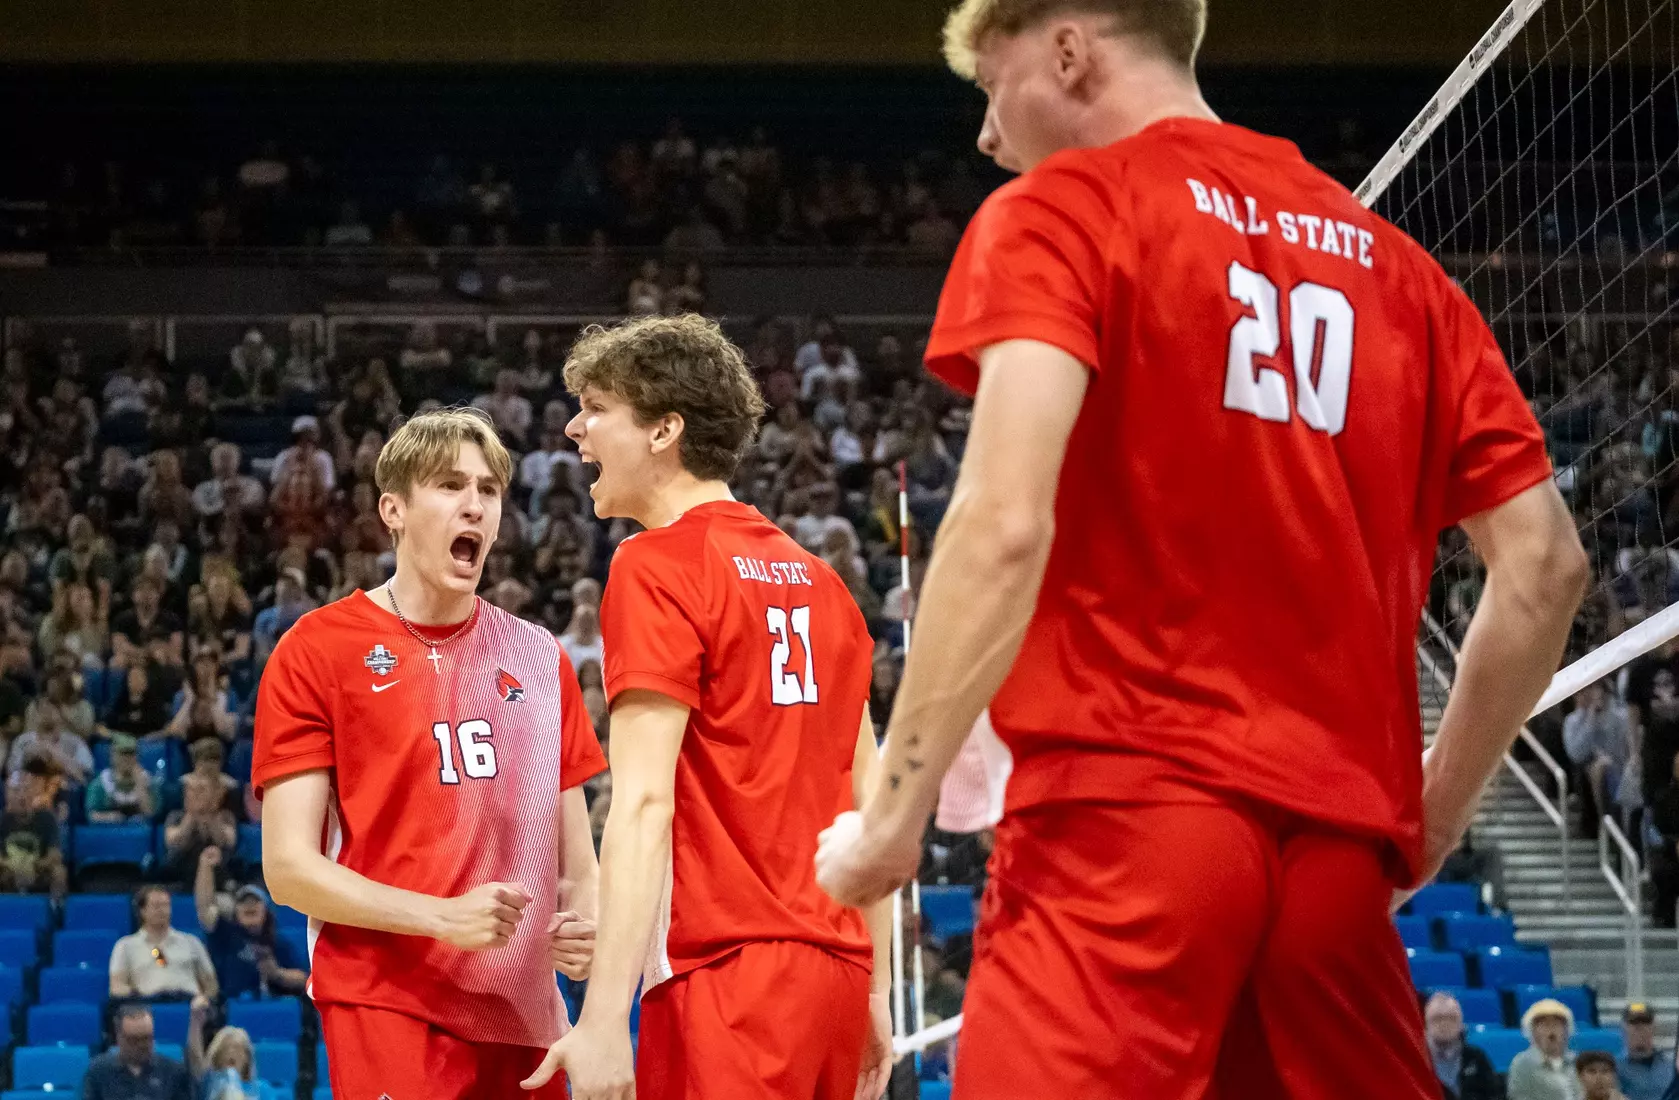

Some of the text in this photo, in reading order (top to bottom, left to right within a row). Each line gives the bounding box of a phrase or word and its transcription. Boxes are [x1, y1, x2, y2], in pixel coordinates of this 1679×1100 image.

[1186, 178, 1374, 269] BALL STATE
[1223, 260, 1355, 436] 20
[732, 555, 771, 583] BALL
[766, 605, 819, 705] 21
[432, 718, 499, 785] 16
